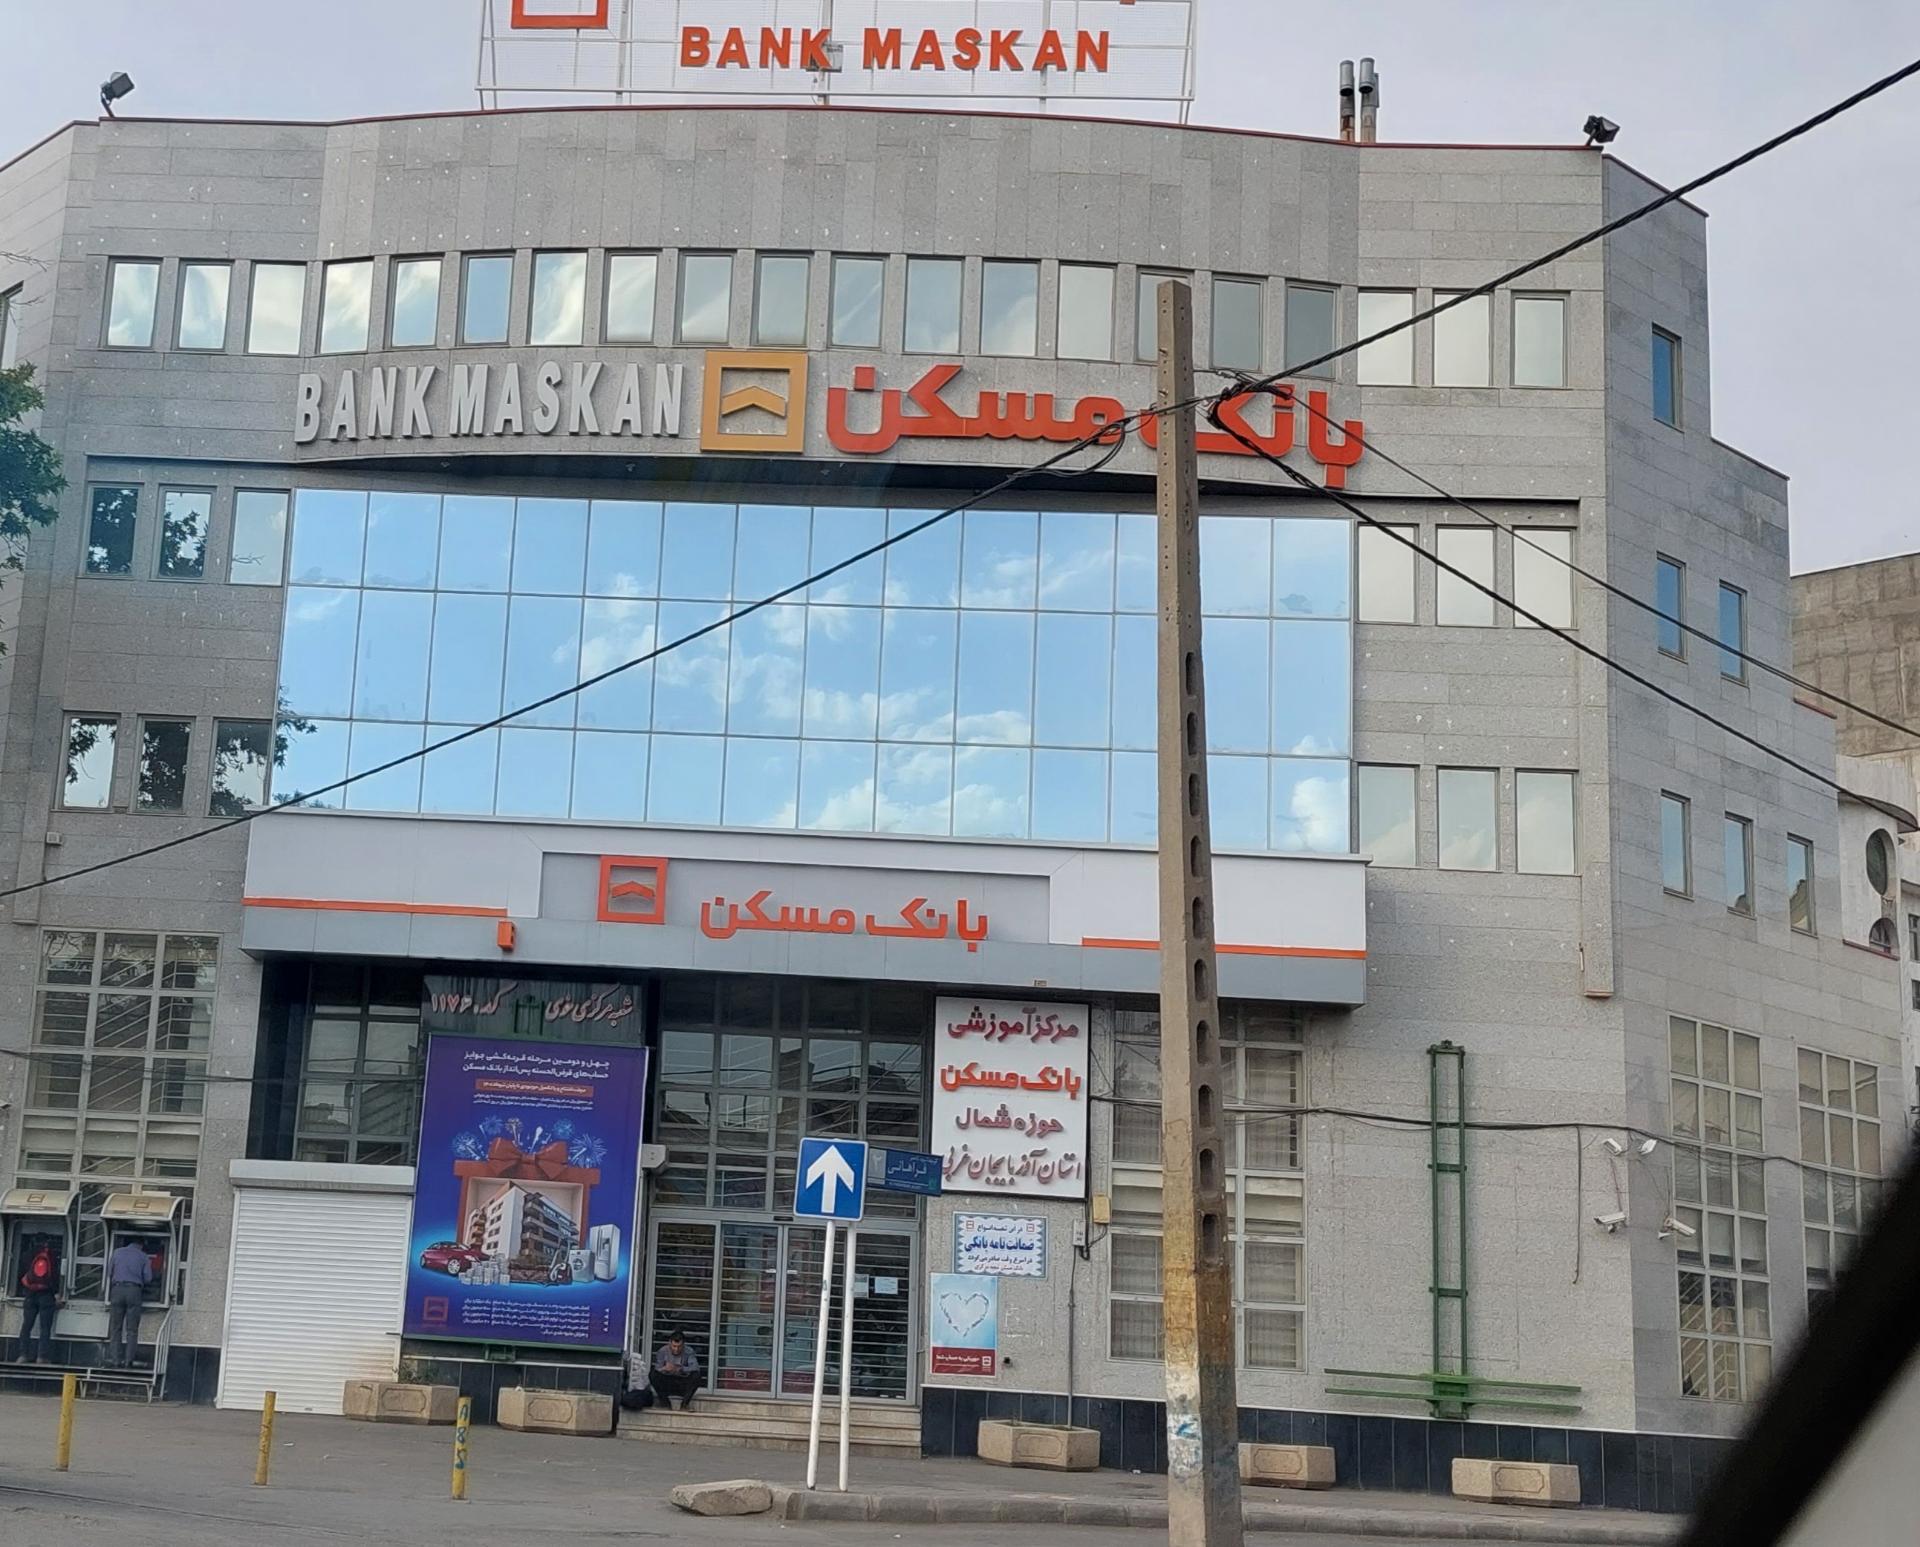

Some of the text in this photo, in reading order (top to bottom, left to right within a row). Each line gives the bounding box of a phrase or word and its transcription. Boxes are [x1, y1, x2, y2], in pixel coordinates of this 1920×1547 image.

[680, 25, 1110, 73] BANK MASKAN
[293, 360, 685, 445] BANK MASKAN
[825, 363, 1365, 490] بانک مسکن
[699, 889, 989, 953] بانک مسکن
[544, 982, 635, 1028] شعبه مرکزی خوی
[947, 1005, 1080, 1044] مرکز آموزشی
[940, 1062, 1082, 1101] بانک مسکن
[955, 1103, 1065, 1139] حوزه شمال
[887, 1160, 928, 1178] فراهانی
[967, 1147, 1048, 1186] آذربایجان
[1037, 1152, 1082, 1185] استان
[964, 1235, 989, 1253] بانکی
